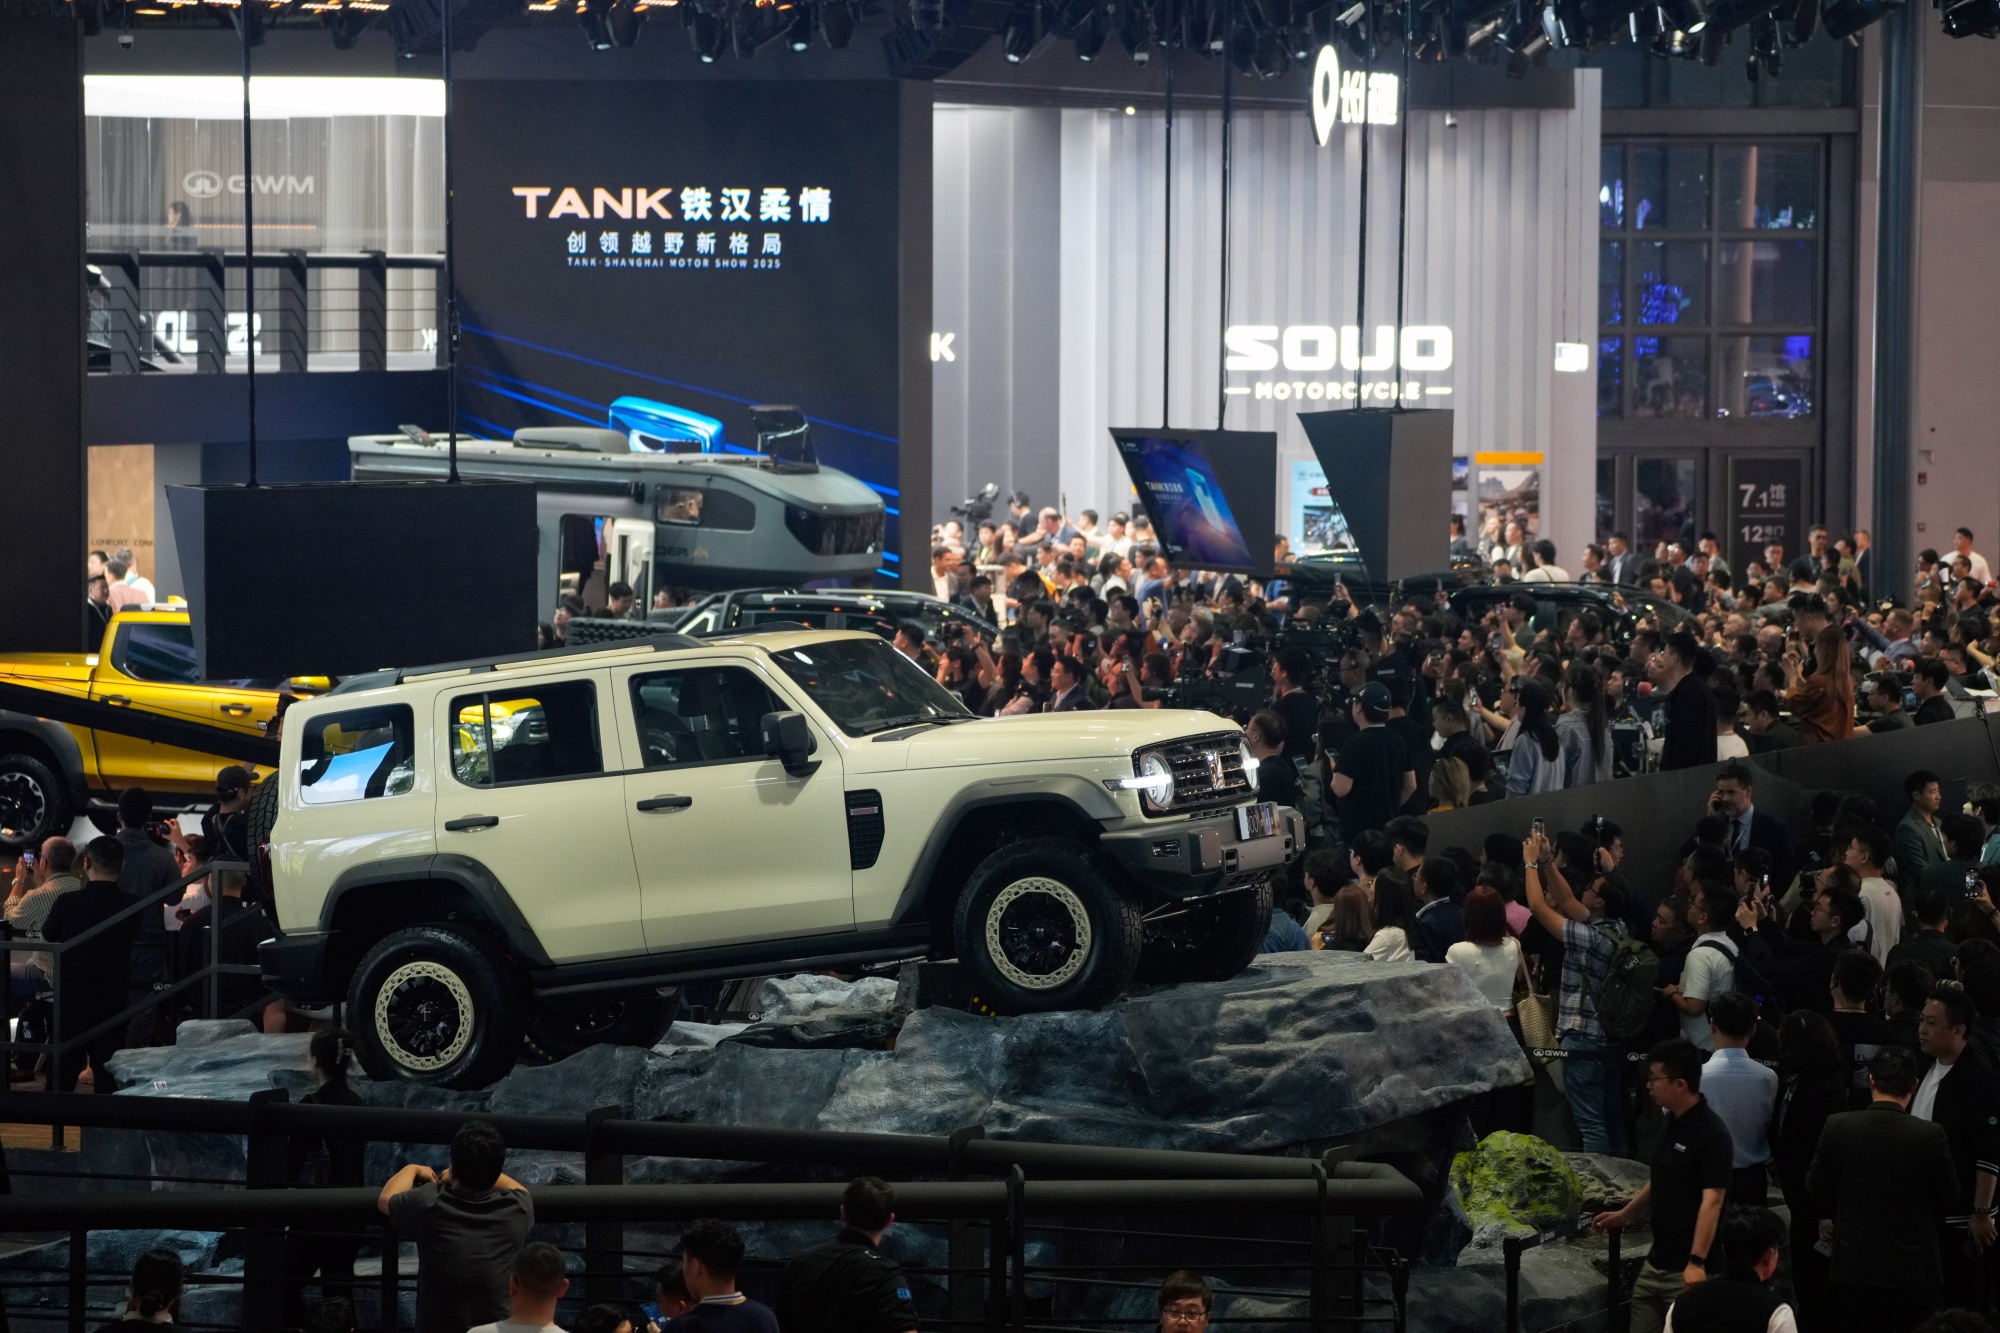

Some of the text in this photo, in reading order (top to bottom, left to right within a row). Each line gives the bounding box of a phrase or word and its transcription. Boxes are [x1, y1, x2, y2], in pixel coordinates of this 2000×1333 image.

[227, 175, 314, 194] GWM
[512, 187, 831, 222] TANK 铁汉柔情
[567, 231, 781, 255] 创领越野新格局
[669, 258, 709, 268] MOTOR
[715, 258, 748, 268] SHOW
[753, 258, 781, 269] 2025
[930, 332, 956, 362] K
[1225, 325, 1453, 371] SOUO
[1255, 381, 1420, 400] MOTORCYCLE
